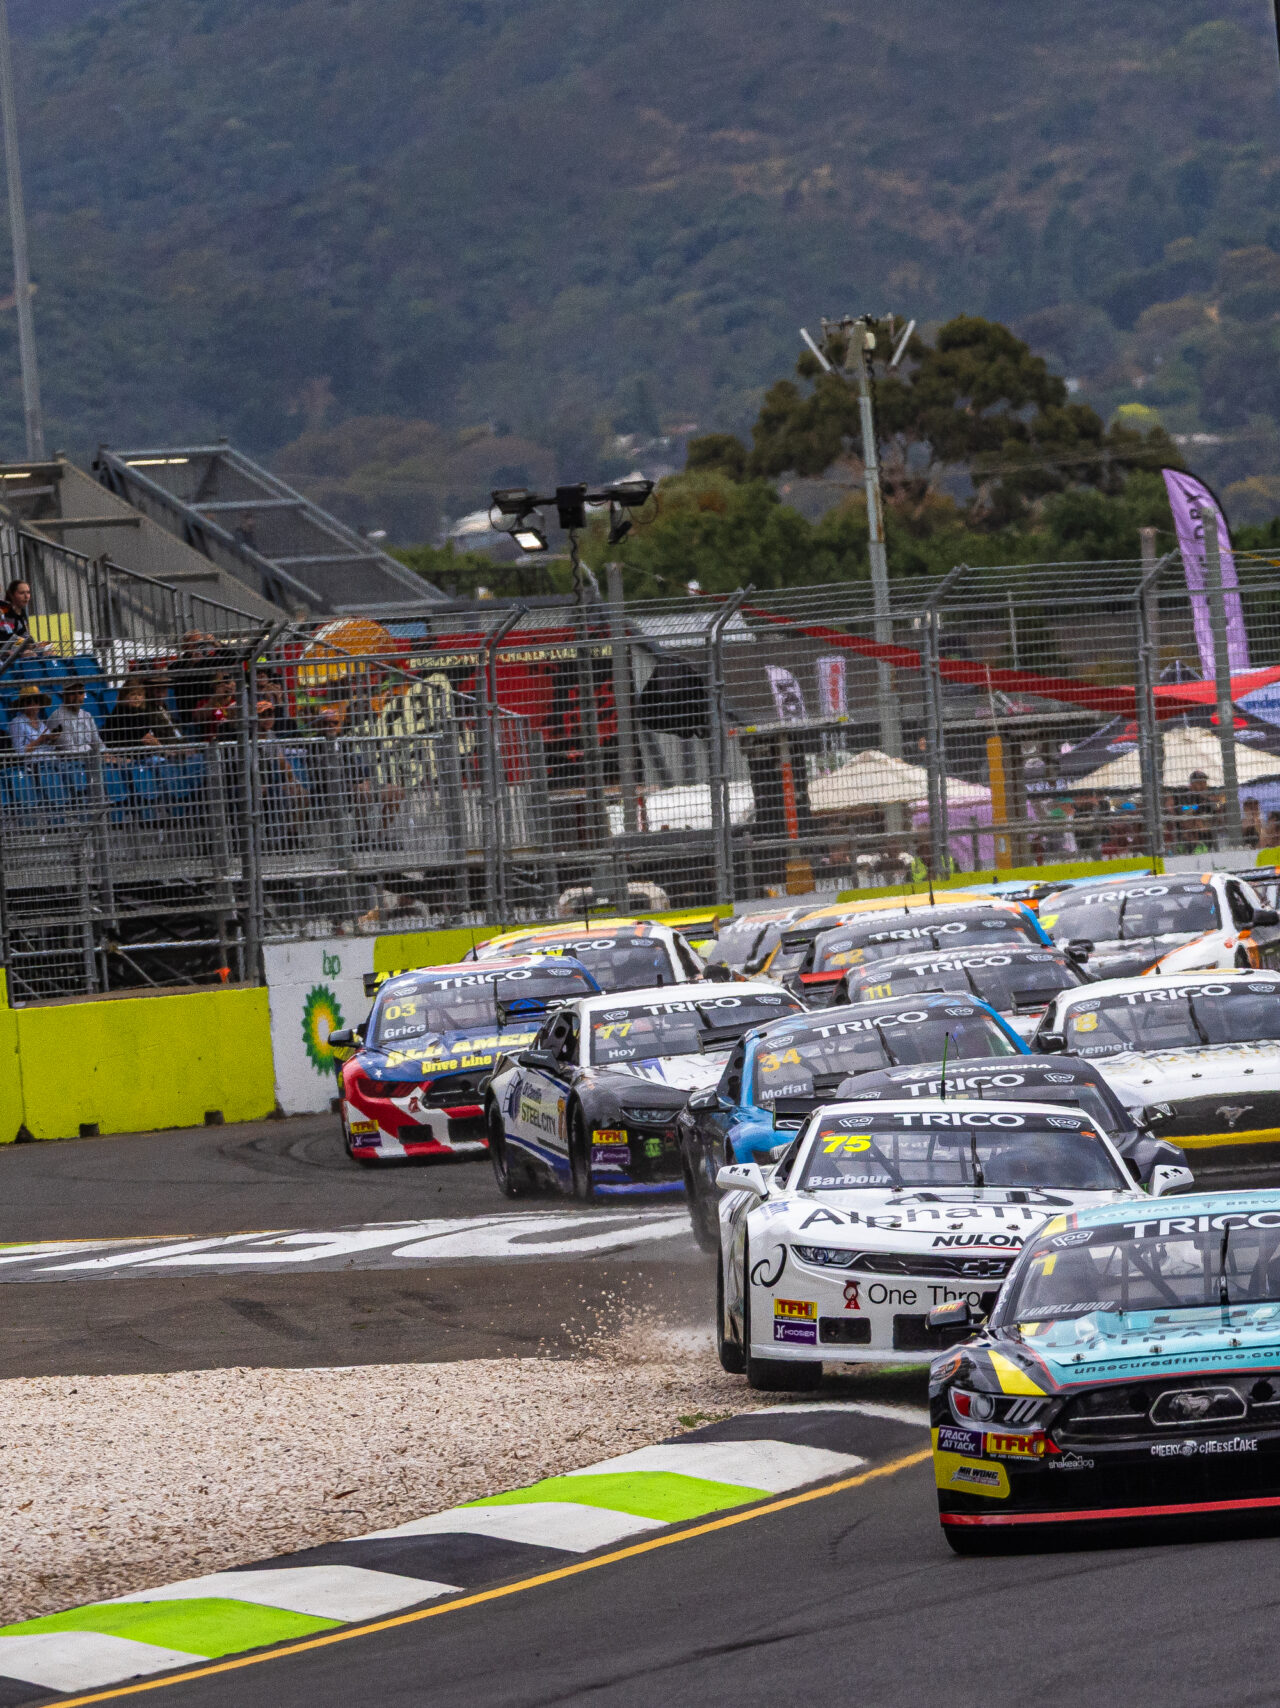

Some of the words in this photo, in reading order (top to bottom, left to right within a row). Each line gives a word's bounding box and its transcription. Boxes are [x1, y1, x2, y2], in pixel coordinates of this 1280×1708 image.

[1082, 886, 1169, 905] TRICO
[868, 922, 967, 941] TRICO
[322, 949, 341, 980] bp
[909, 956, 1012, 976] TRICO
[433, 970, 532, 990] TRICO
[865, 983, 894, 1001] 111
[1120, 985, 1231, 1005] TRICO
[385, 1003, 416, 1021] 03
[643, 997, 742, 1017] TRICO
[812, 1011, 929, 1039] TRICO
[1076, 1012, 1099, 1032] 8
[384, 1024, 426, 1040] Grice
[601, 1023, 633, 1040] 77
[384, 1045, 443, 1068] ALL
[608, 1047, 637, 1059] Hoy
[760, 1048, 801, 1073] 34
[422, 1057, 458, 1075] Drive
[461, 1053, 492, 1069] Line
[761, 1083, 808, 1099] Moffat
[902, 1074, 1025, 1097] TRICO
[894, 1113, 1026, 1127] TRICO
[822, 1135, 872, 1153] 75
[808, 1174, 892, 1187] Barbour
[1135, 1204, 1191, 1214] TIMES
[1034, 1254, 1057, 1276] 1
[868, 1283, 917, 1305] One
[779, 1300, 809, 1316] TFH
[940, 1428, 972, 1442] TRACK
[992, 1433, 1033, 1453] TFH
[942, 1440, 976, 1451] ATTACK
[1151, 1444, 1181, 1456] CHEEKY
[1049, 1458, 1095, 1469] shakeadog
[972, 1469, 999, 1479] WONG
